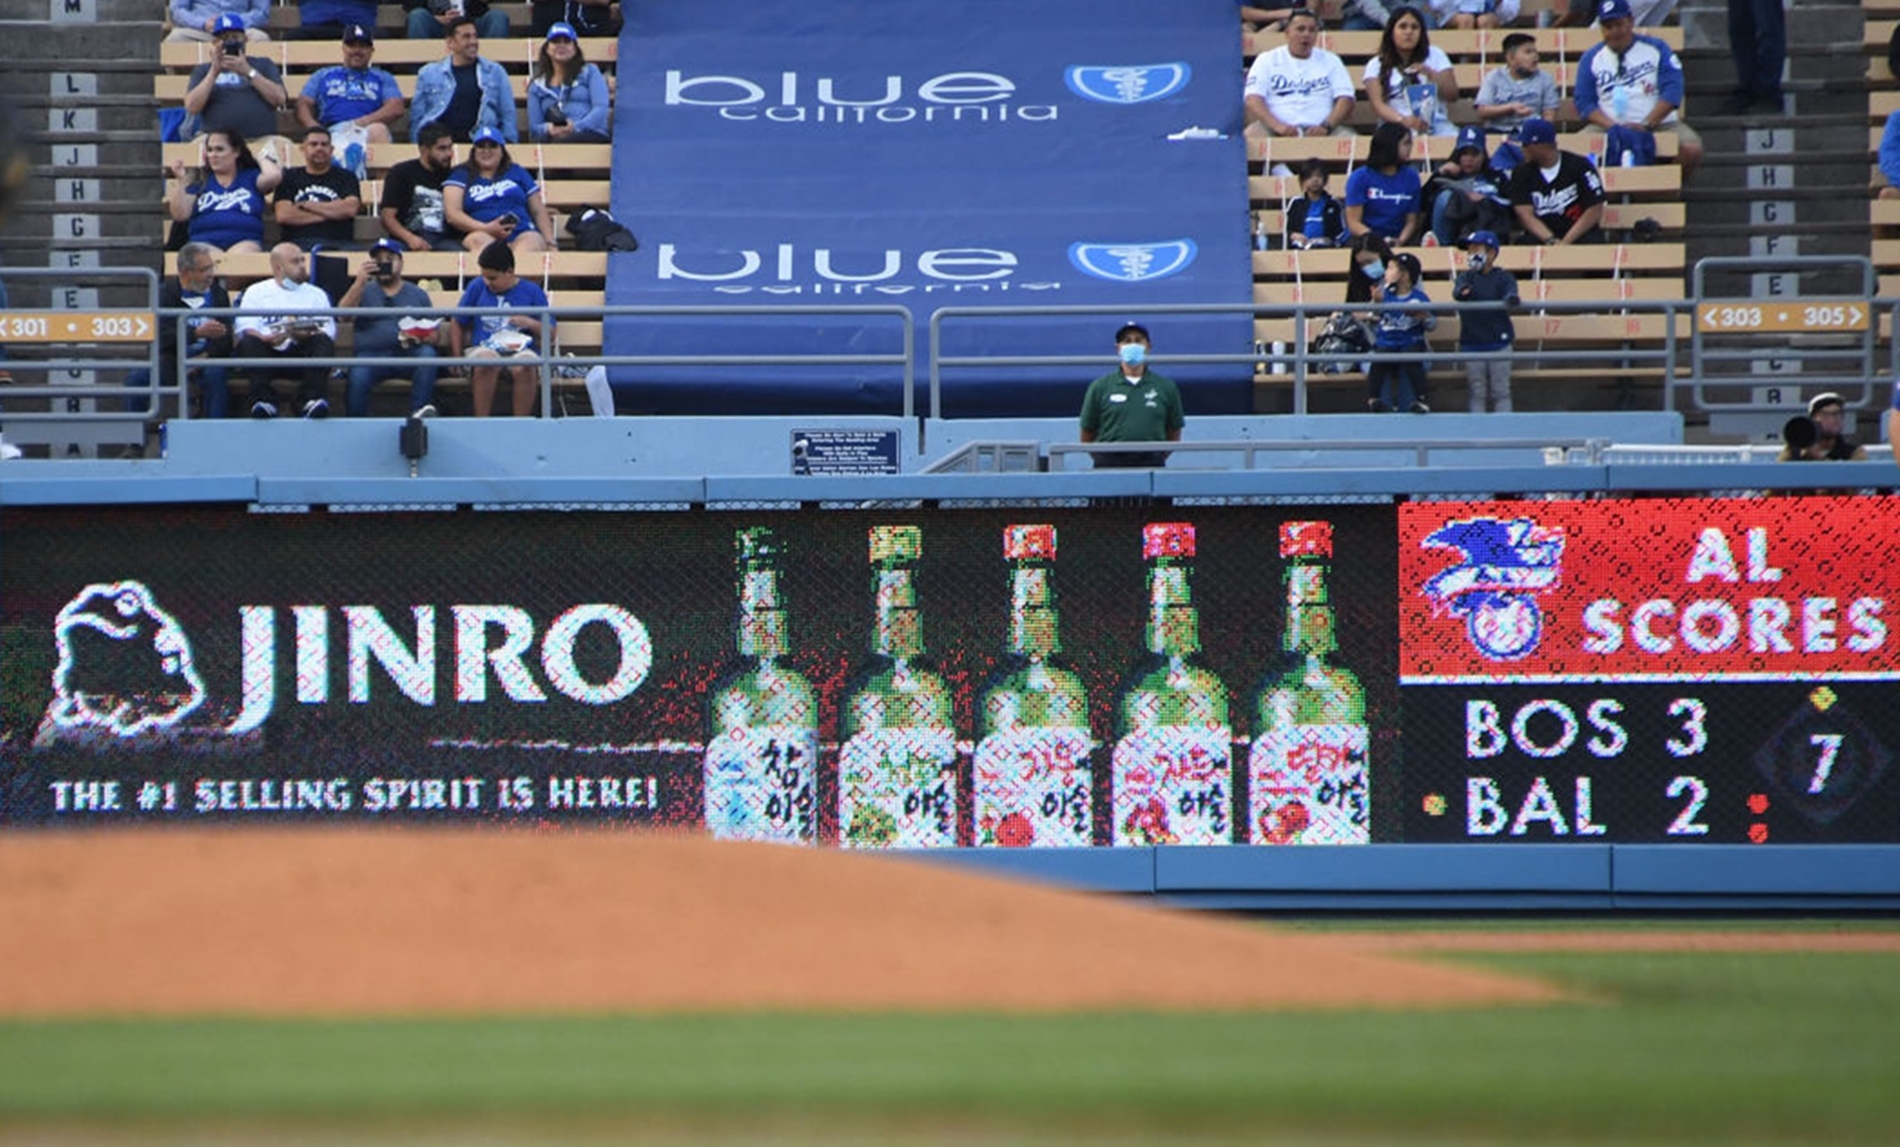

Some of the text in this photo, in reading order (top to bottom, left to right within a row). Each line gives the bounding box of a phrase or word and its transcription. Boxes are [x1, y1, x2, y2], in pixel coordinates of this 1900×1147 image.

[64, 0, 81, 13] M
[66, 74, 79, 93] L
[665, 70, 1016, 106] blue
[1271, 73, 1331, 97] Dodgers
[63, 111, 76, 129] K
[719, 104, 1059, 123] california
[1762, 132, 1775, 149] J
[67, 148, 78, 165] J
[1762, 168, 1776, 186] H
[71, 181, 84, 199] H
[1763, 202, 1777, 221] G
[71, 218, 84, 236] G
[1767, 236, 1780, 255] F
[657, 243, 1018, 282] blue
[1769, 275, 1782, 295] E
[65, 290, 79, 308] E
[1721, 307, 1763, 327] 303
[1804, 306, 1846, 326] 305
[11, 318, 47, 337] 301
[92, 317, 132, 336] 303
[1687, 526, 1784, 584] AL
[1582, 597, 1888, 654] SCORES
[227, 603, 653, 734] JINRO
[1465, 698, 1708, 759] BOS 3
[1807, 733, 1844, 795] 7
[49, 777, 659, 811] THE #1 SELLING SPIRIT IS HERE!
[1466, 775, 1710, 836] BAL 2
